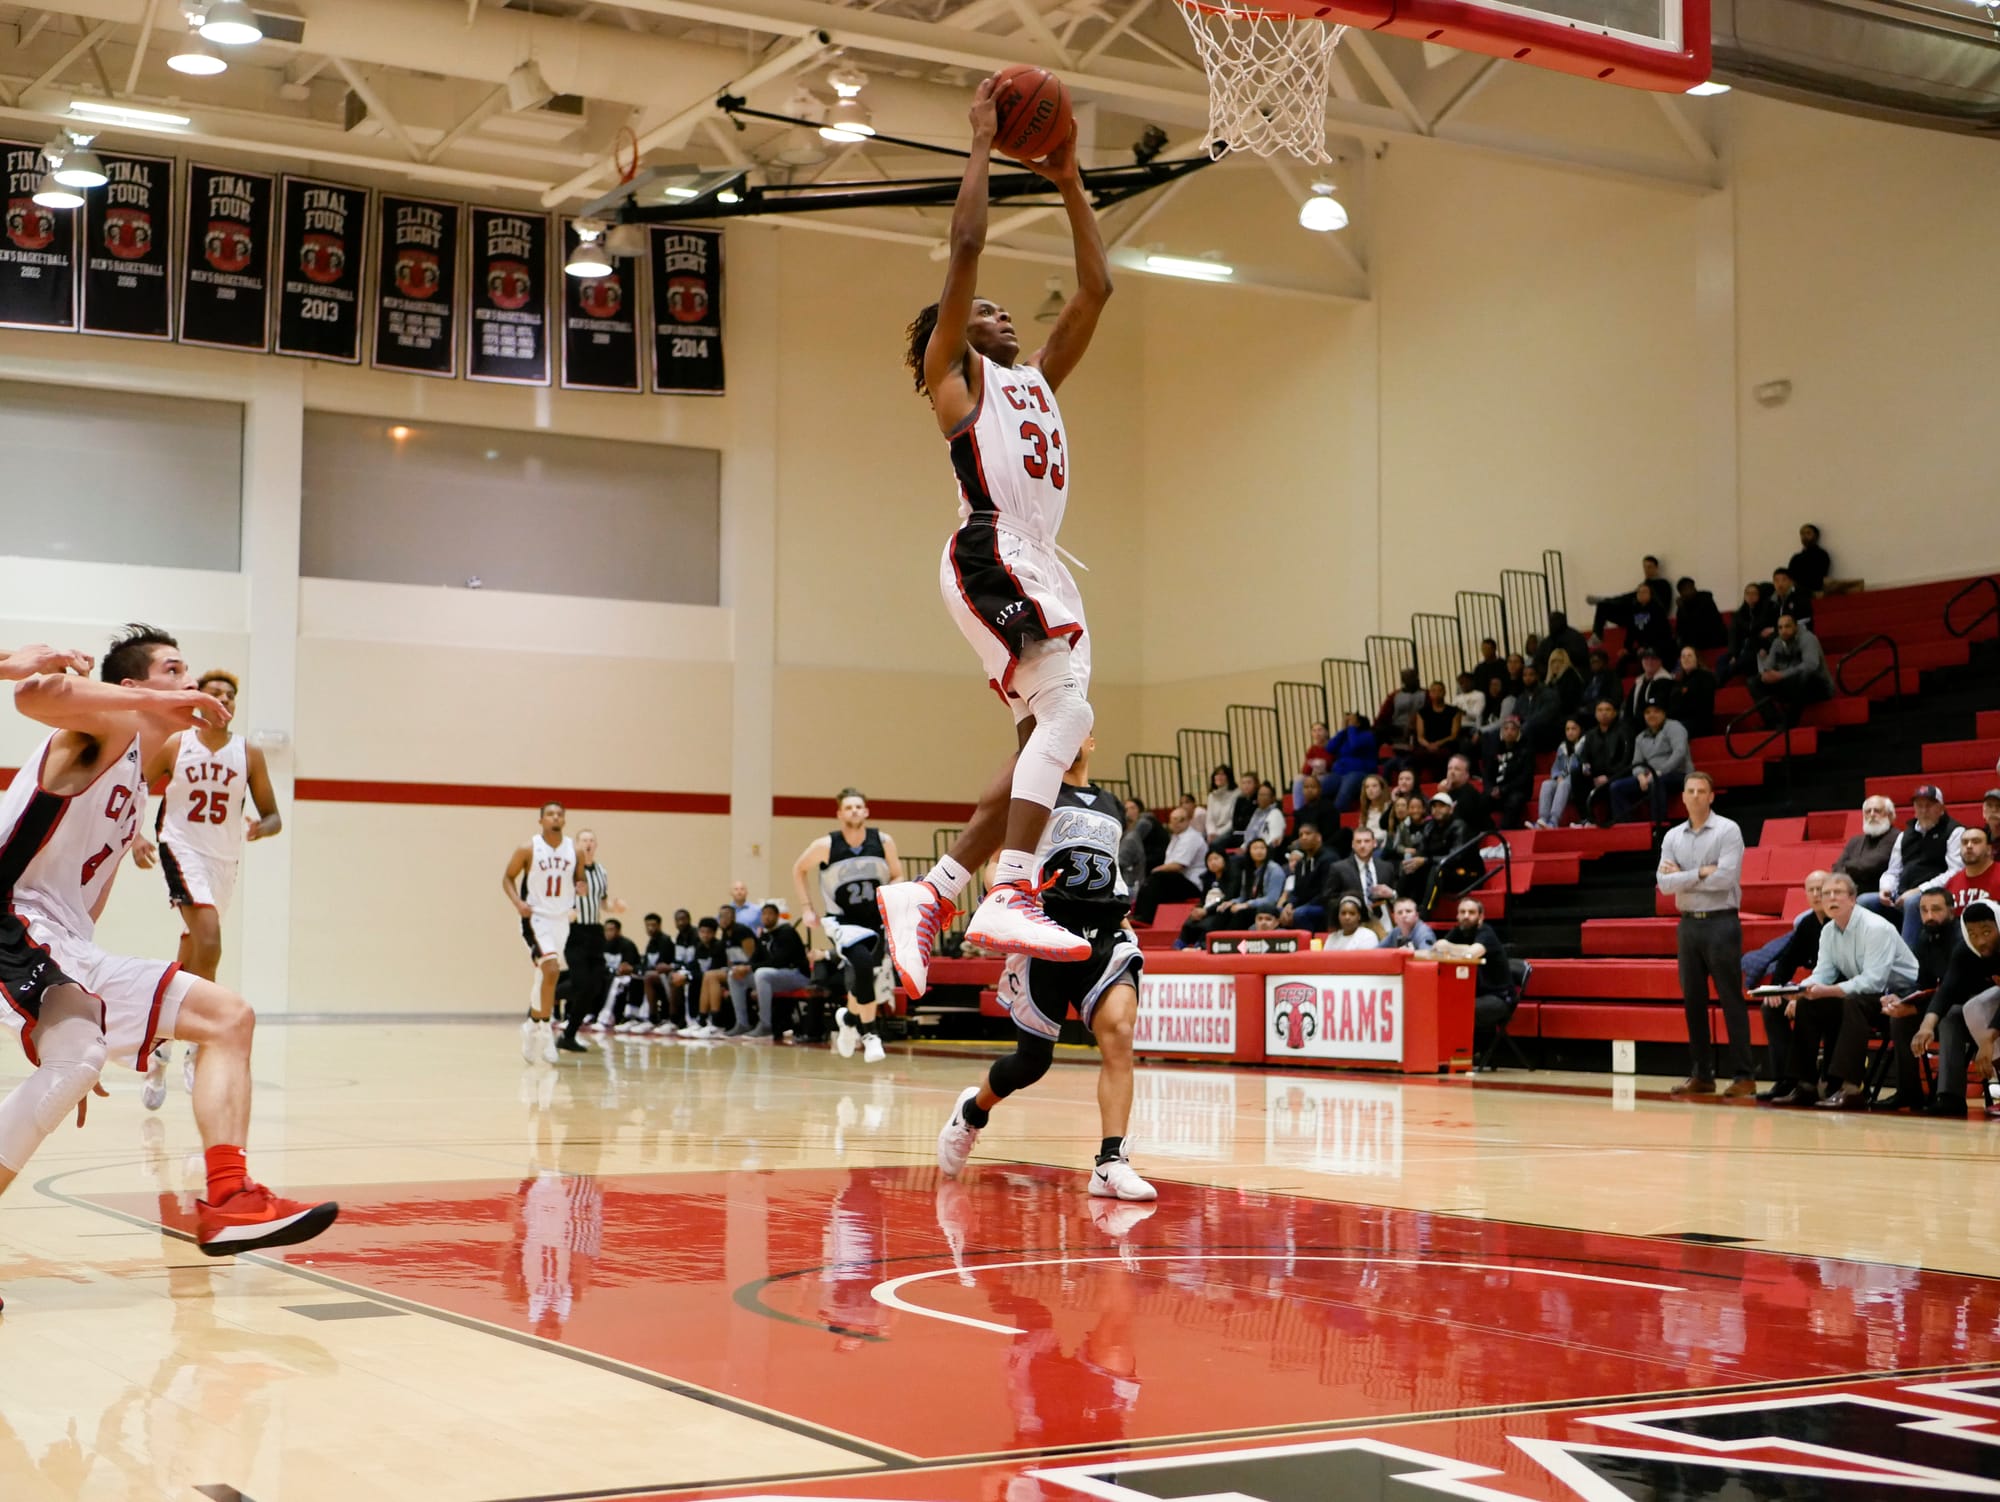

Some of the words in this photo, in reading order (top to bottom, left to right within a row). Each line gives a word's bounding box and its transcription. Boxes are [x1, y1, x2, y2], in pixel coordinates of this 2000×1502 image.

[1013, 98, 1055, 148] Wilson
[7, 150, 50, 173] FINA
[9, 172, 42, 193] FOU
[105, 162, 152, 188] FINAL
[107, 183, 149, 208] FOUR
[208, 176, 255, 203] FINAL
[210, 197, 250, 222] FOUR
[302, 189, 348, 216] FINAL
[304, 210, 344, 235] FOUR
[397, 206, 442, 231] ELITE
[487, 218, 531, 241] ELITE
[396, 225, 442, 249] EIGHT
[487, 236, 531, 259] EIGHT
[664, 235, 707, 256] ELITE
[17, 251, 69, 266] BASKETBALL
[112, 260, 164, 276] BASKETBALL
[665, 253, 707, 274] EIGHT
[300, 298, 339, 322] 2013
[671, 337, 709, 359] 2014
[1020, 420, 1065, 491] 33
[996, 600, 1025, 626] CITY
[184, 762, 238, 787] CITY
[187, 790, 230, 825] 25
[538, 857, 571, 871] CITY
[1065, 850, 1114, 890] 33
[545, 875, 562, 897] 11
[846, 880, 875, 905] 24
[1952, 887, 1990, 908] IT
[1140, 983, 1154, 1009] TY
[1158, 983, 1213, 1009] COLLEGE
[1219, 983, 1236, 1009] OF
[1321, 988, 1394, 1043] RAMS
[1135, 1015, 1153, 1041] AN
[1158, 1016, 1230, 1044] FRANCISCO
